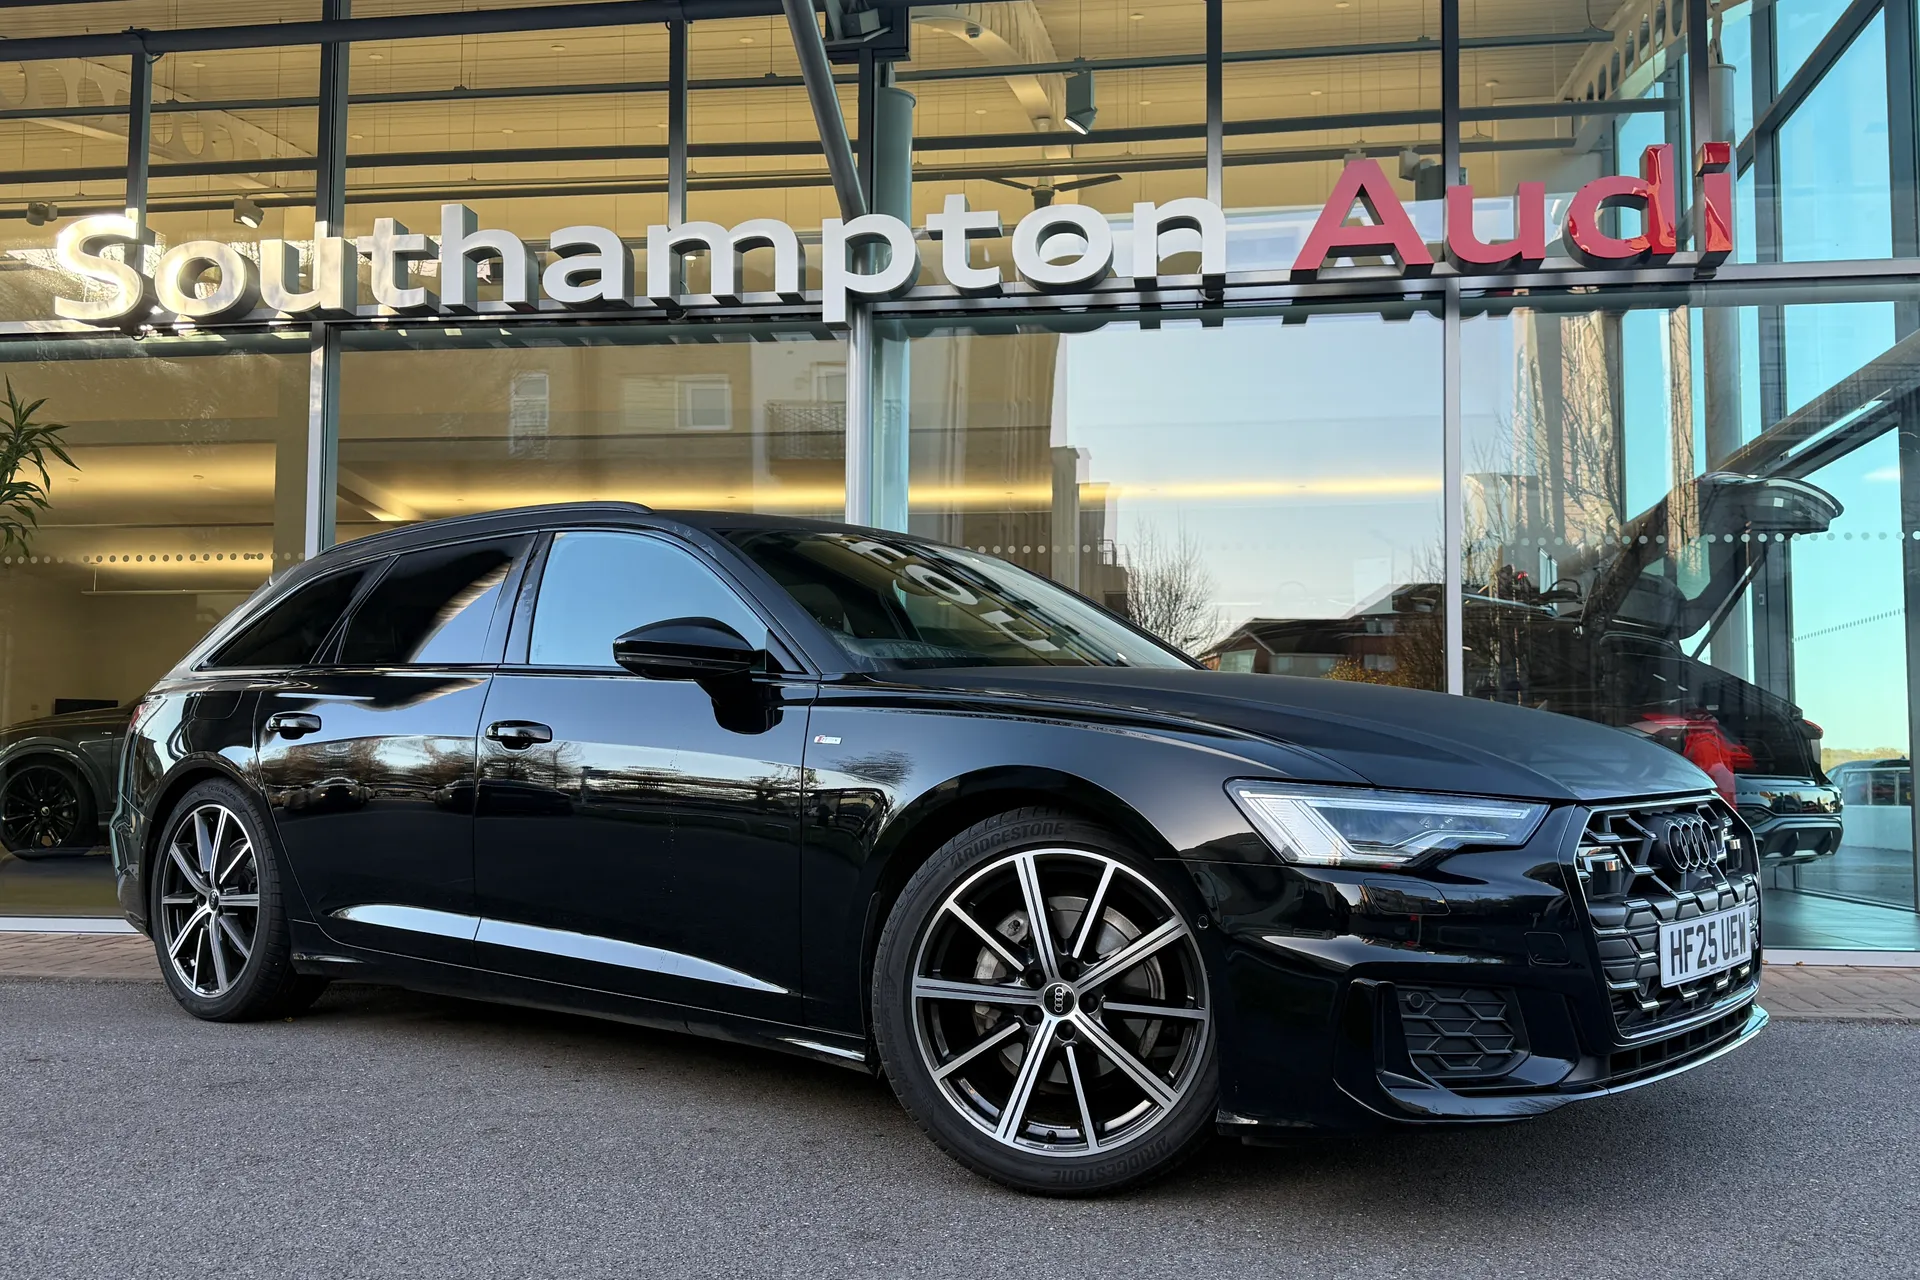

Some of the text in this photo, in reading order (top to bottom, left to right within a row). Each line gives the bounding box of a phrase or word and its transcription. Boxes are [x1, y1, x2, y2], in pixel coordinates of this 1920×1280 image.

[54, 142, 1734, 324] Southampton Audi
[949, 821, 1065, 871] BRIDGESTONE
[1670, 921, 1717, 976] HF25
[1050, 1135, 1172, 1184] BRIDGESTONE
